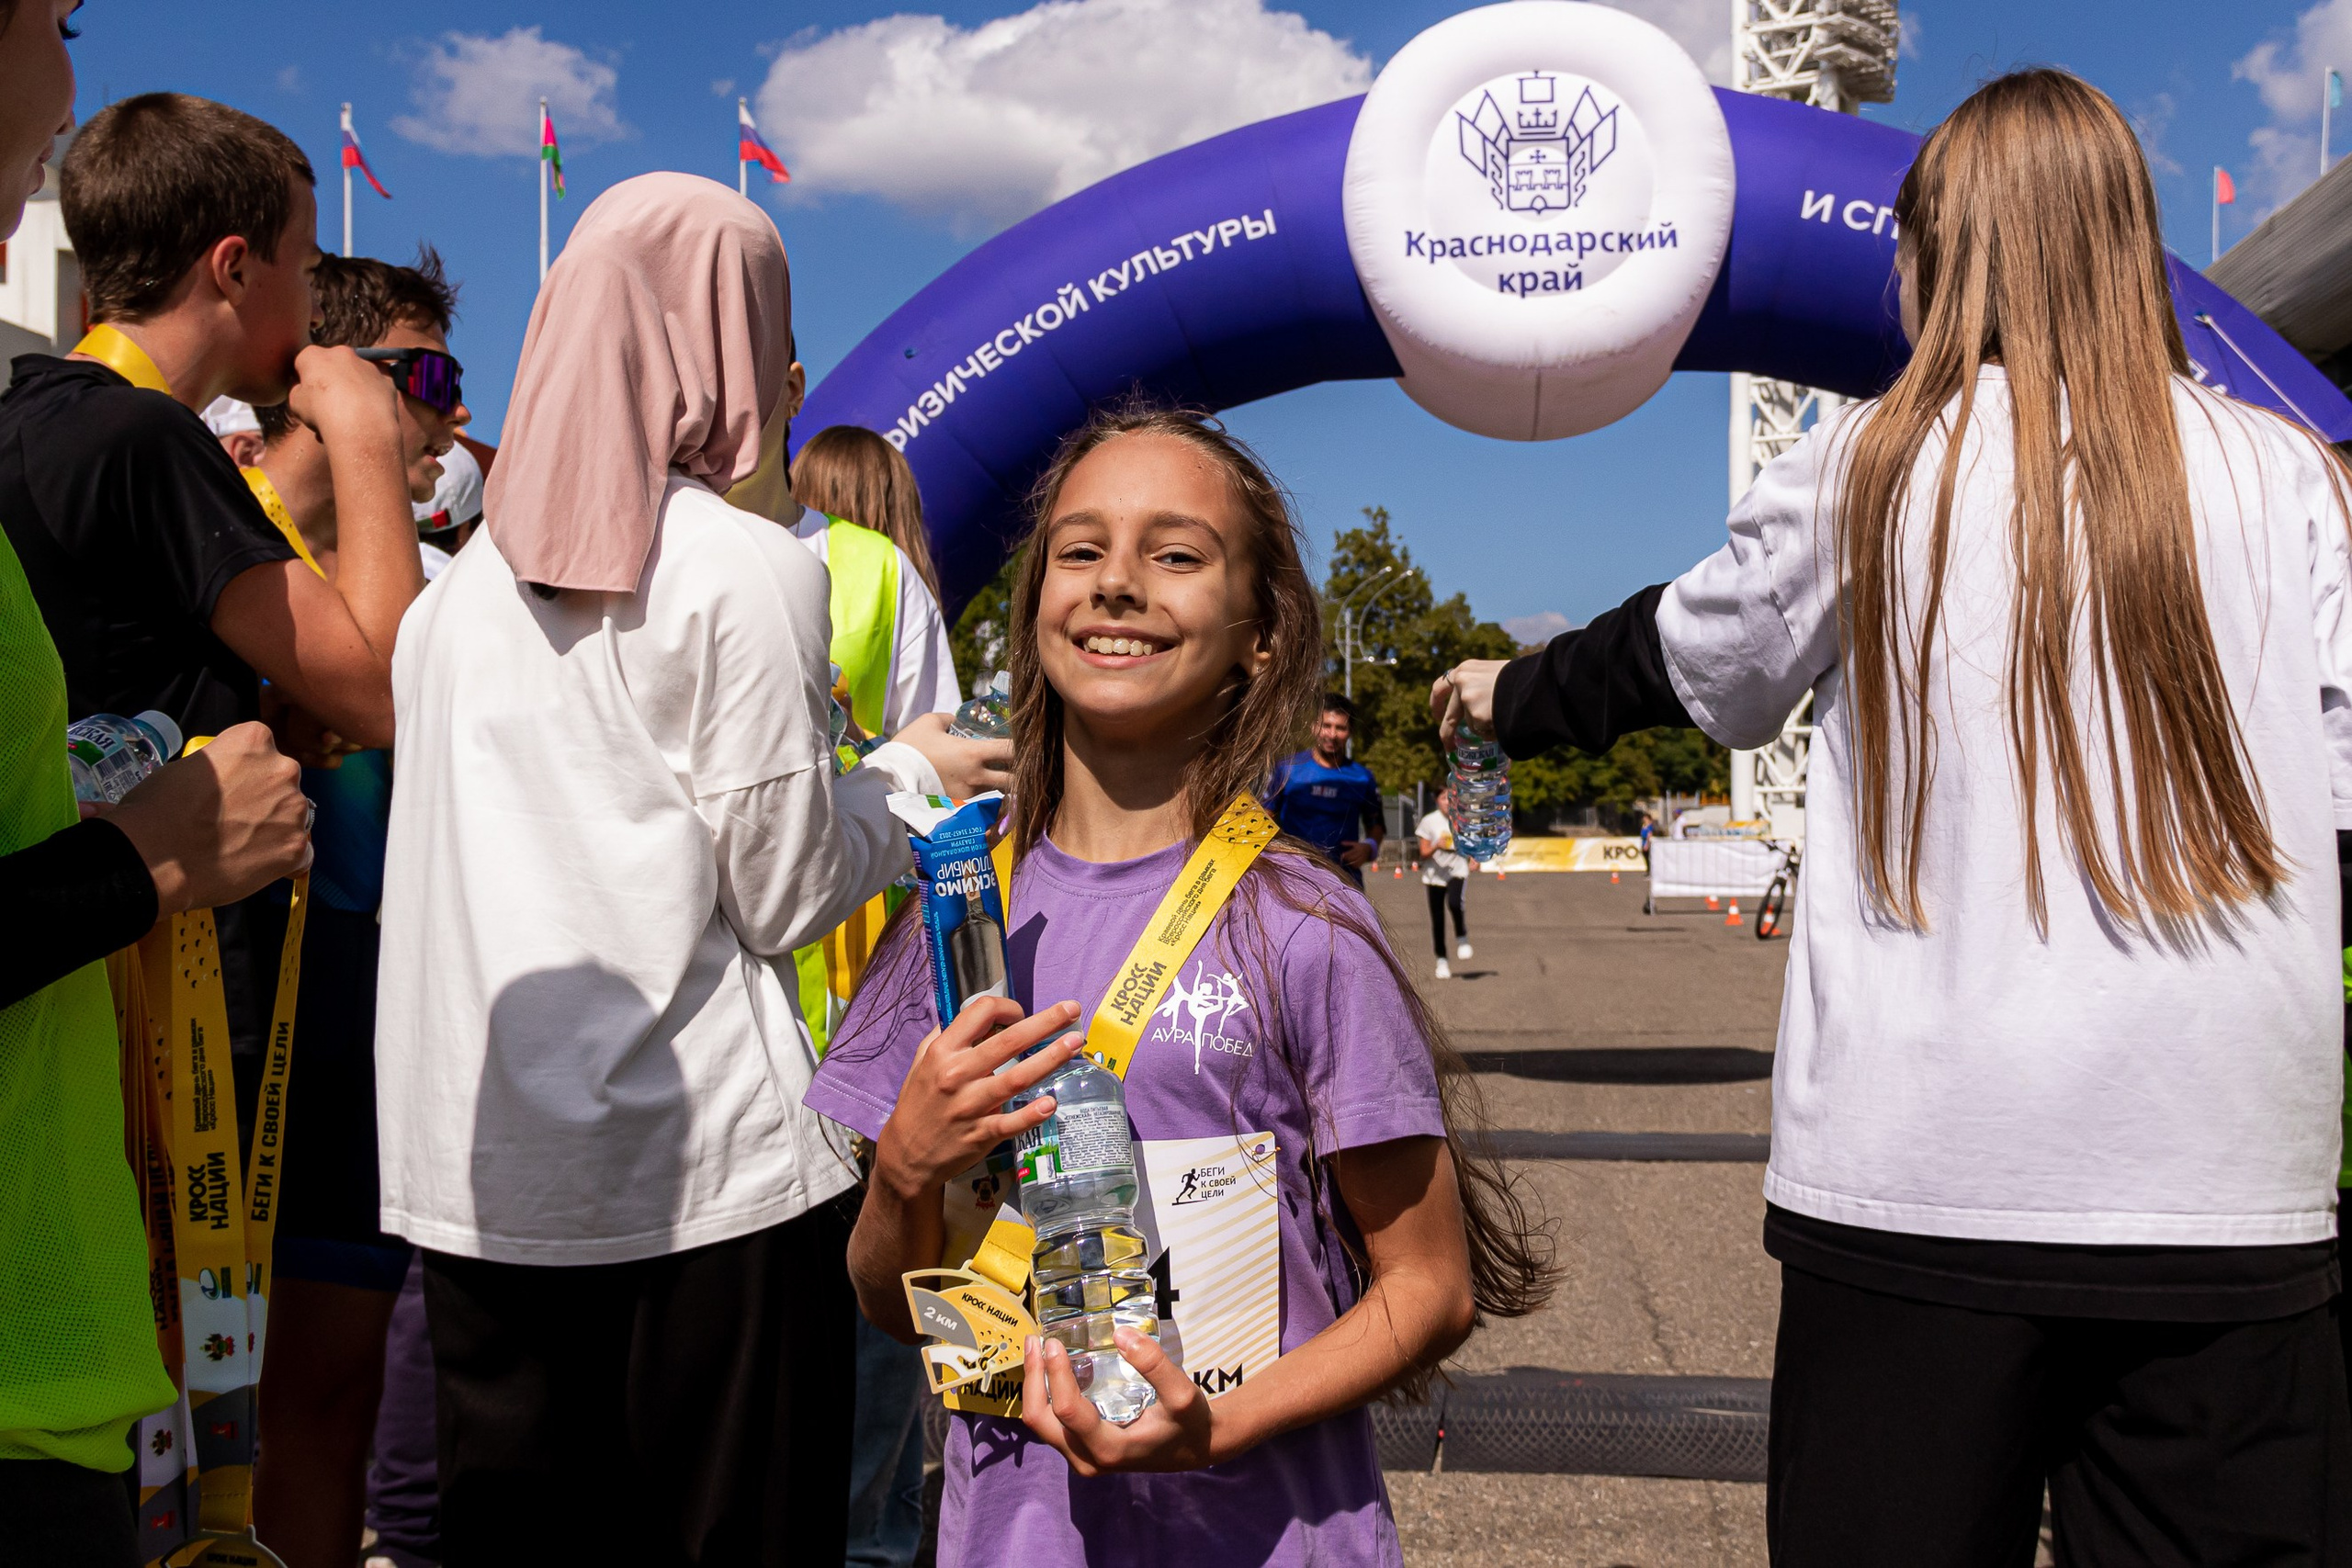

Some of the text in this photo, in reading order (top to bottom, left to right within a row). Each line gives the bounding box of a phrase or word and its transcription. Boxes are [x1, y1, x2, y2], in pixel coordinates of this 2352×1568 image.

[1801, 189, 1836, 223] И
[1086, 208, 1278, 304] КУЛЬТУРЫ
[1405, 222, 1679, 265] Краснодарский
[1498, 263, 1583, 299] край
[930, 845, 970, 860] ШОКОЛАДНОЙ
[951, 838, 975, 848] ГЛАЗУРИ
[935, 871, 996, 897] ЭСКИМО
[937, 855, 992, 880] ПЛОМБИР
[1176, 899, 1188, 915] день
[1185, 885, 1198, 898] бега
[1198, 859, 1216, 882] рамках
[1163, 868, 1216, 944] Всероссийского дня бега
[1110, 963, 1148, 1010] КРОСС
[1120, 961, 1167, 1026] НАЦИИ
[1150, 1028, 1195, 1045] АУРА
[251, 1021, 289, 1222] БЕГИ К СВОЕЙ ЦЕЛИ
[1200, 1167, 1225, 1178] БЕГИ
[1208, 1175, 1237, 1188] СВОЕЙ
[187, 1164, 209, 1223] КРОСС
[207, 1152, 230, 1230] НАЦИИ
[1201, 1190, 1225, 1199] ЦЕЛИ
[923, 1306, 937, 1320] 2
[936, 1314, 958, 1331] КМ
[961, 1292, 987, 1311] КРОСС
[986, 1304, 1019, 1327] НАЦИИ
[1193, 1362, 1243, 1395] КМ
